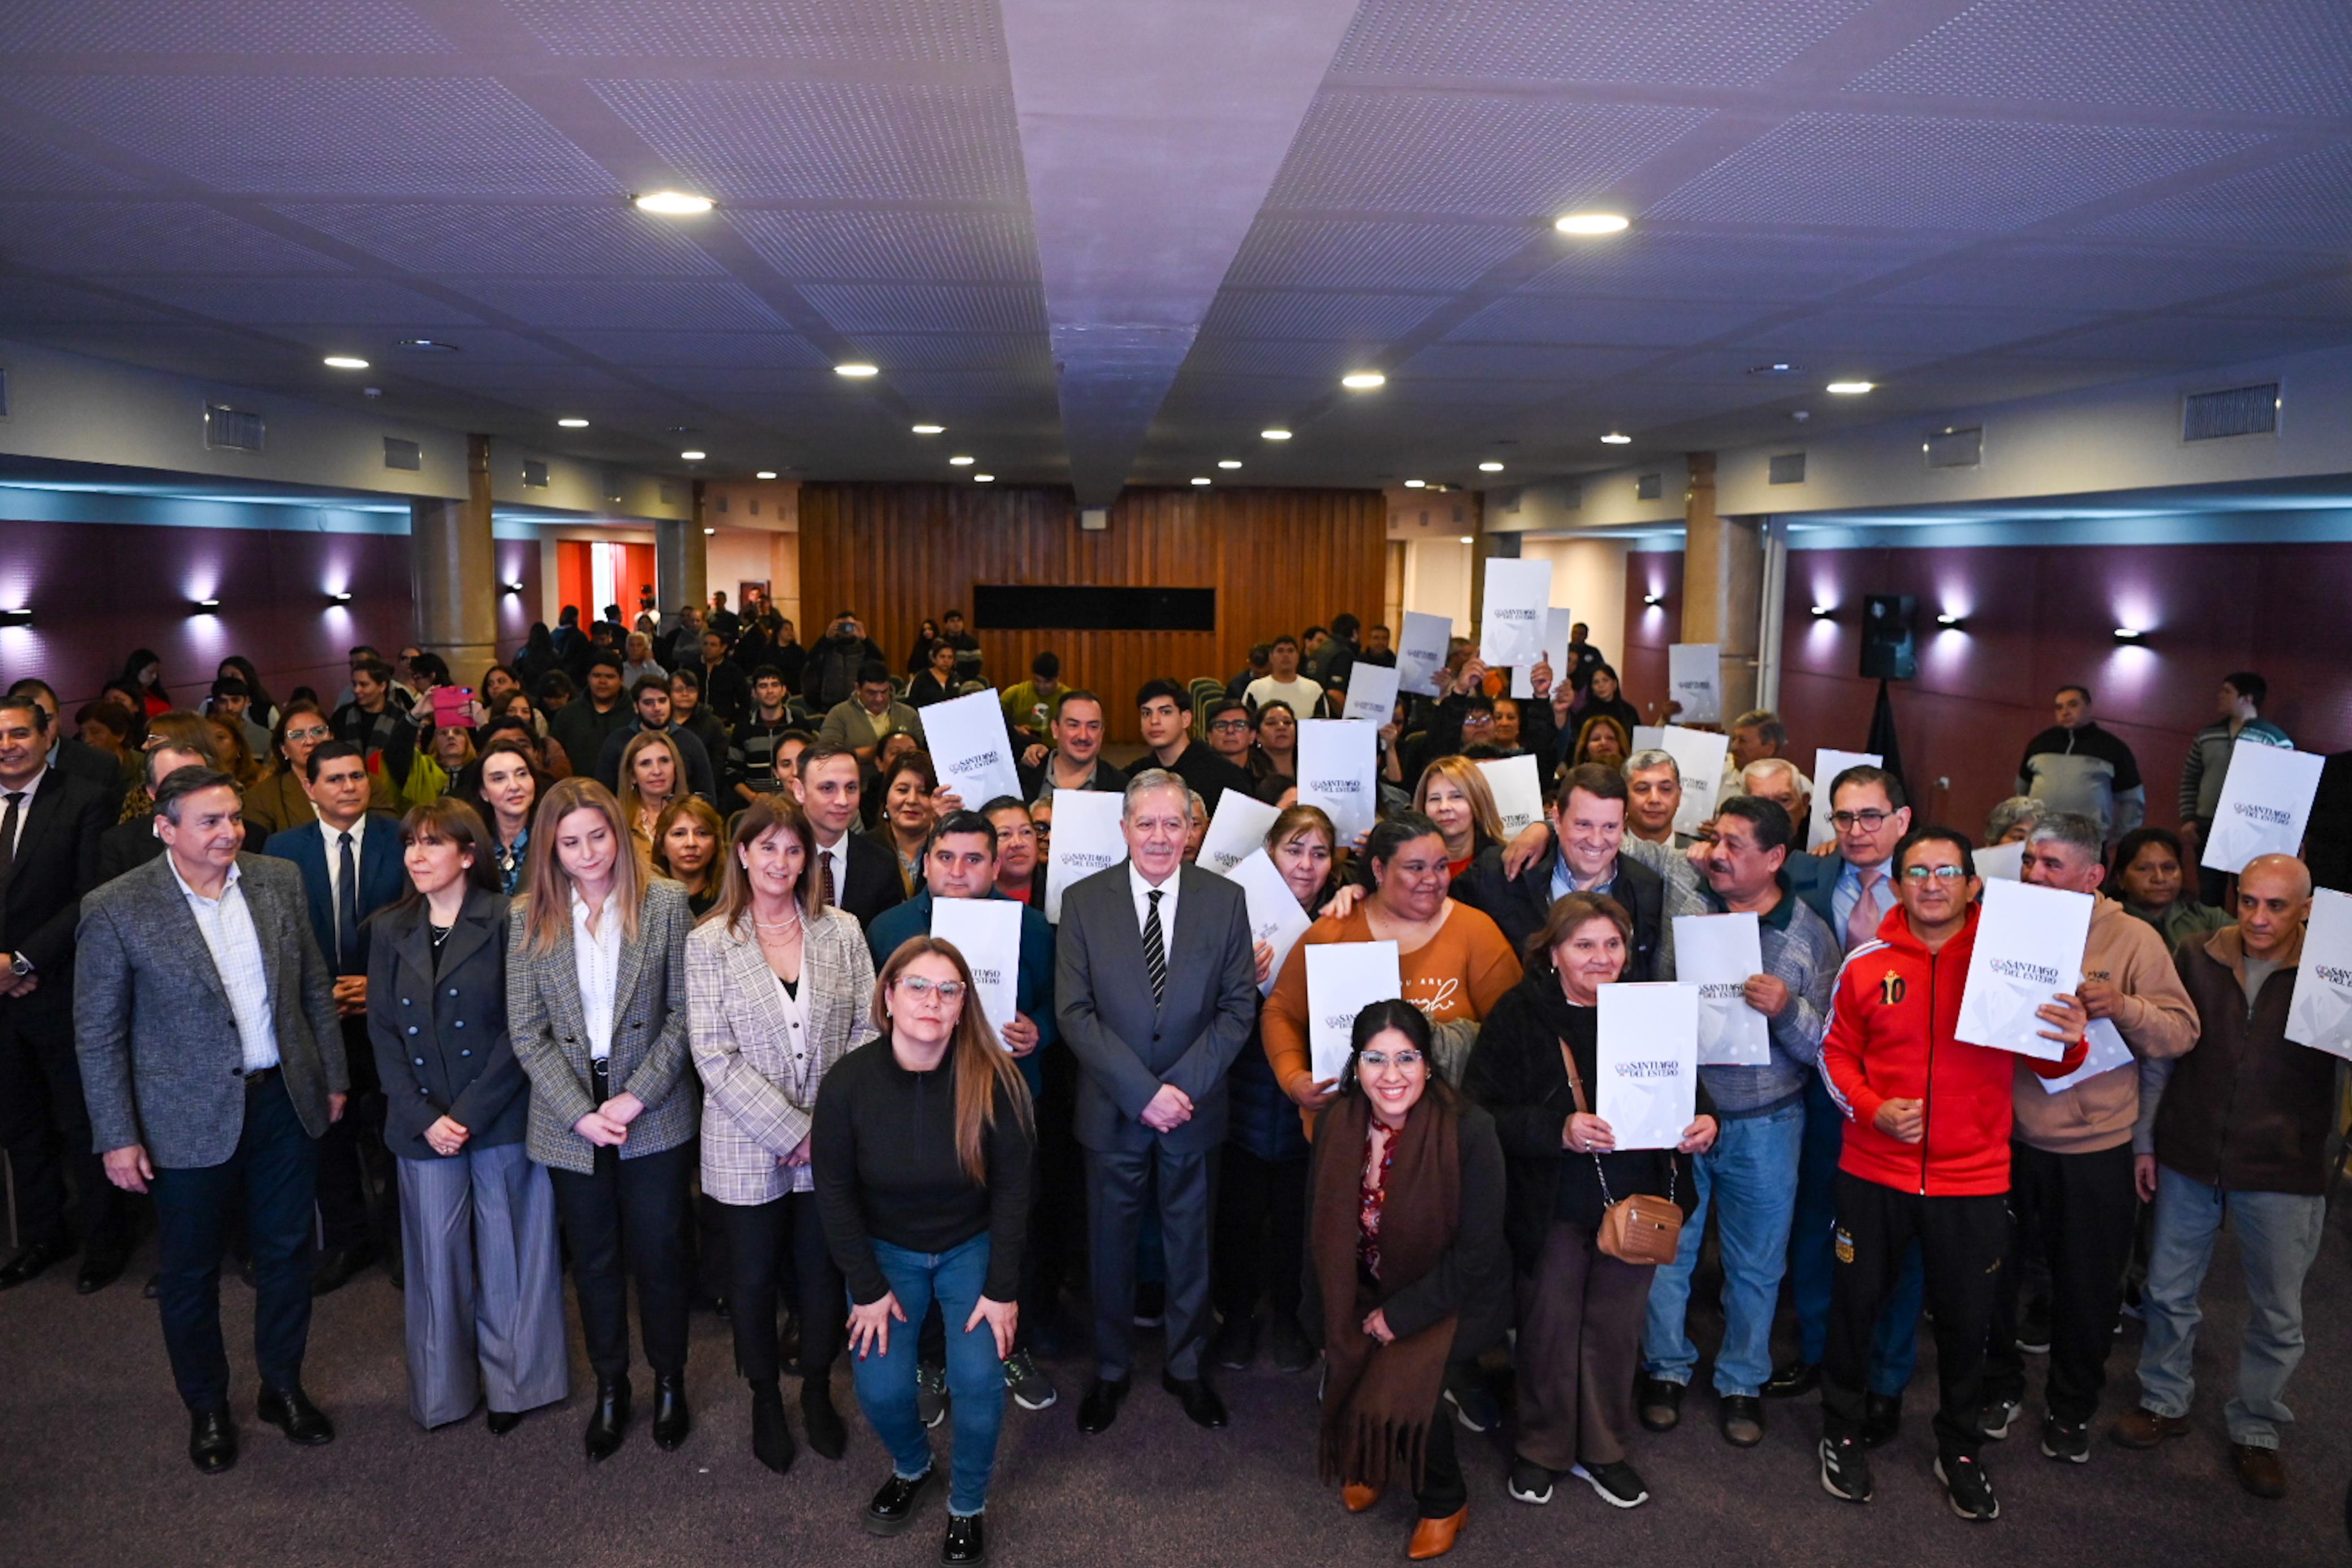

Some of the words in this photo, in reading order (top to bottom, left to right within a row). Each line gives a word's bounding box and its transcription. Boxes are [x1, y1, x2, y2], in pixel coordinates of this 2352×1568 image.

[2247, 804, 2291, 819] SANTIAGO
[1072, 852, 1112, 863] SANTIAGO
[2004, 967, 2022, 978] DEL
[2023, 972, 2057, 985] ESTERO
[2007, 959, 2059, 977] SANTIAGO
[1878, 978, 1906, 1004] 10
[1629, 1060, 1679, 1069] SANTIAGO
